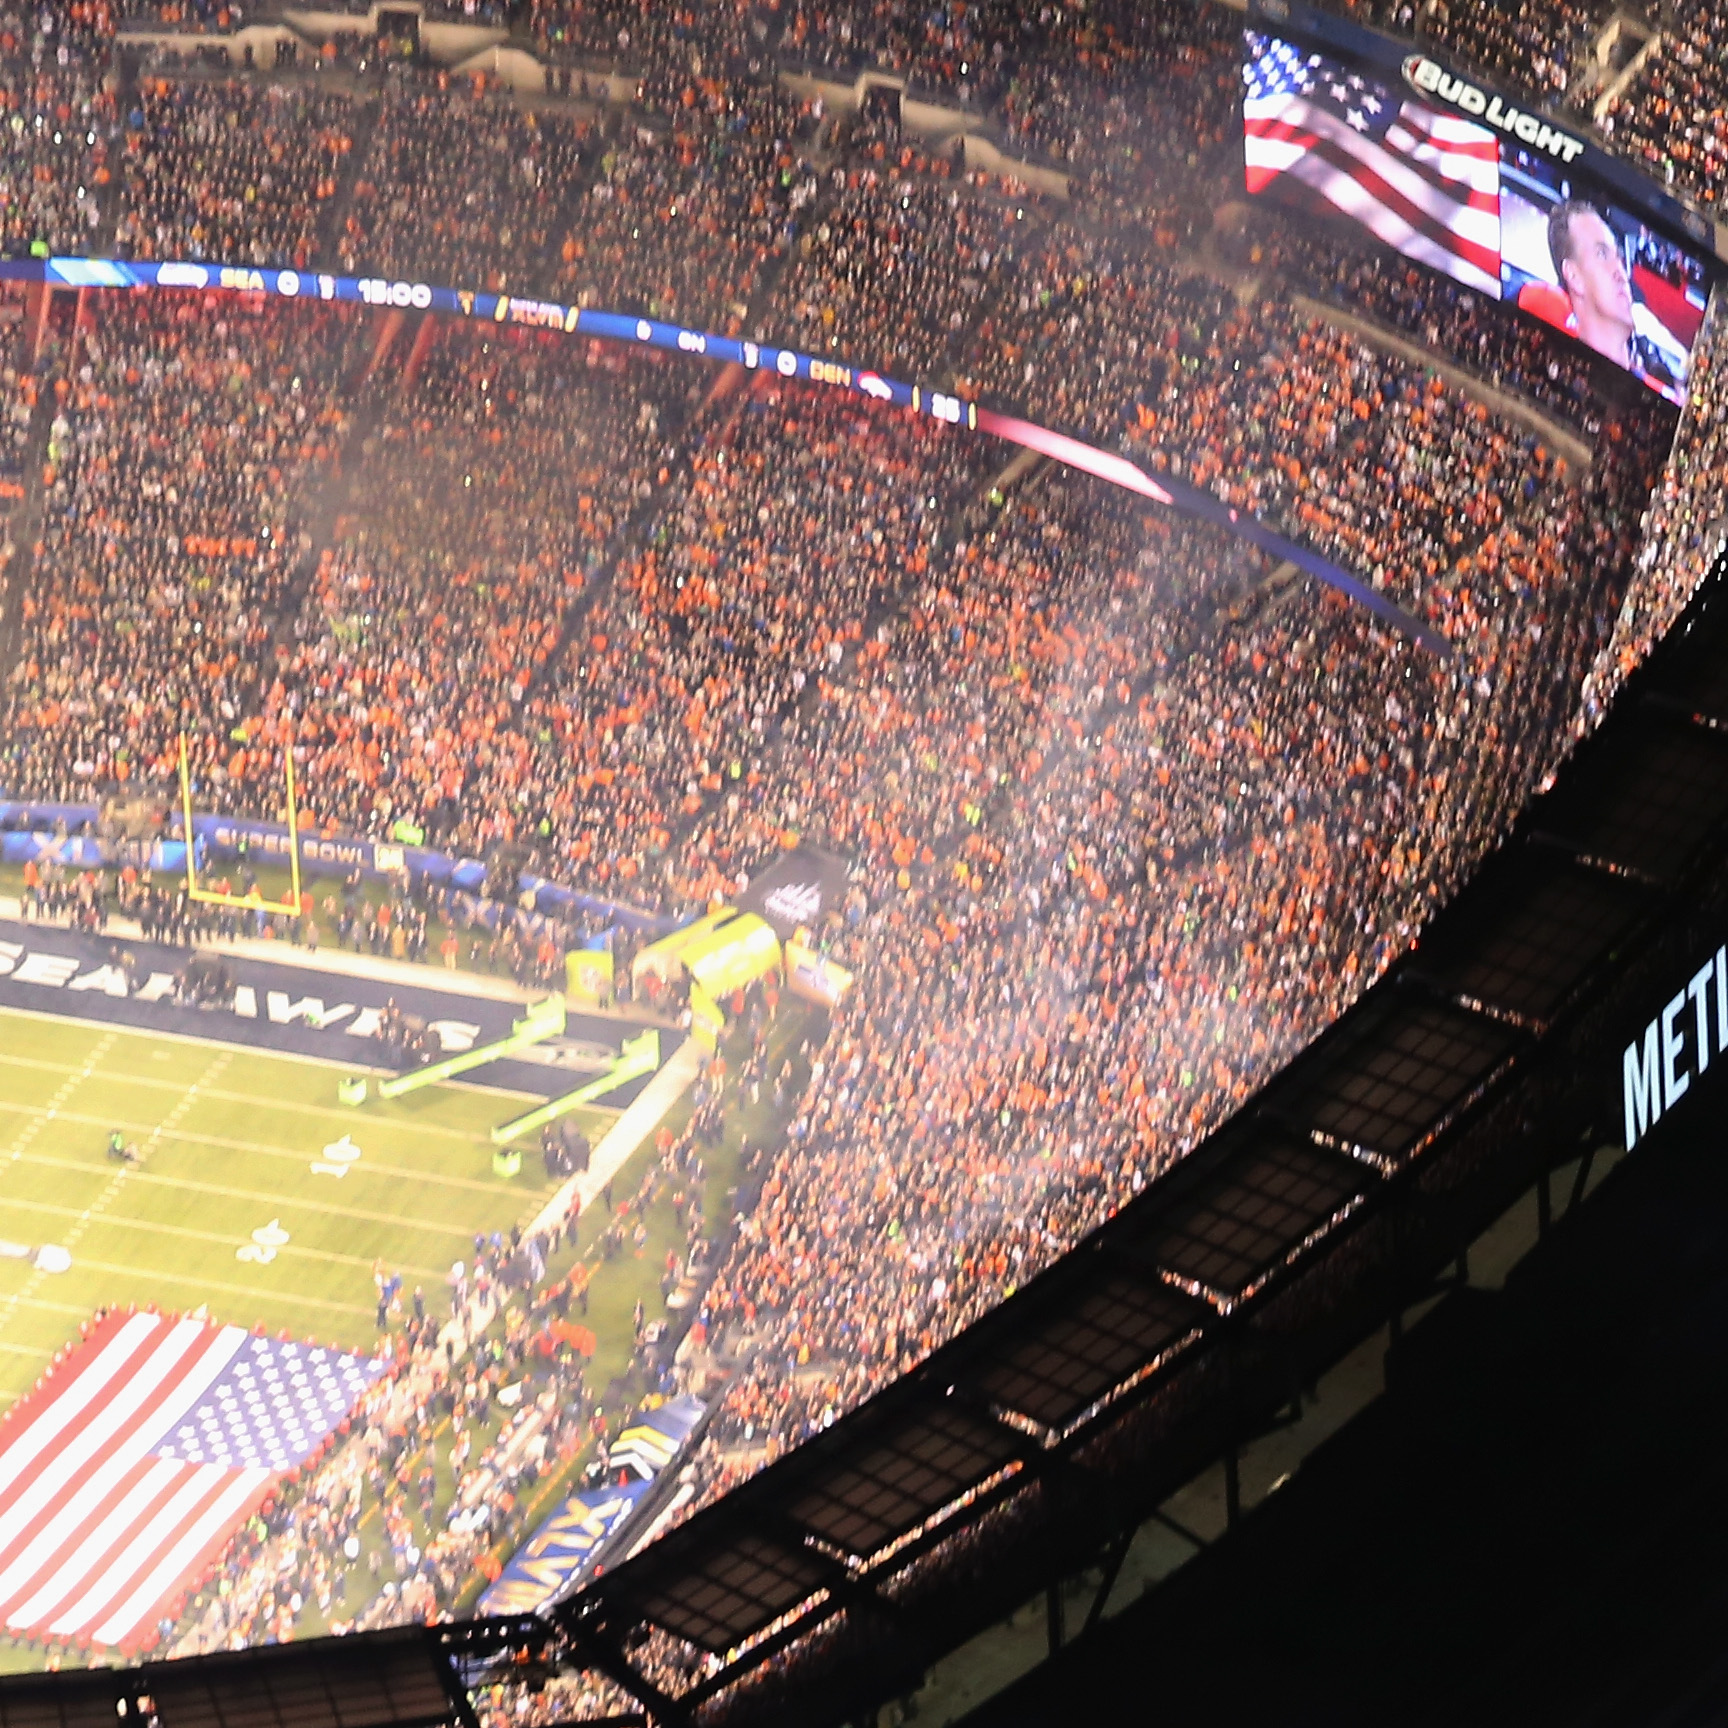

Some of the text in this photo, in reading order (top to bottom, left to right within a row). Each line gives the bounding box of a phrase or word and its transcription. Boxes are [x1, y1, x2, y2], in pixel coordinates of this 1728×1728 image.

[1410, 62, 1584, 163] BUD LIGHT
[357, 278, 432, 309] 15:00
